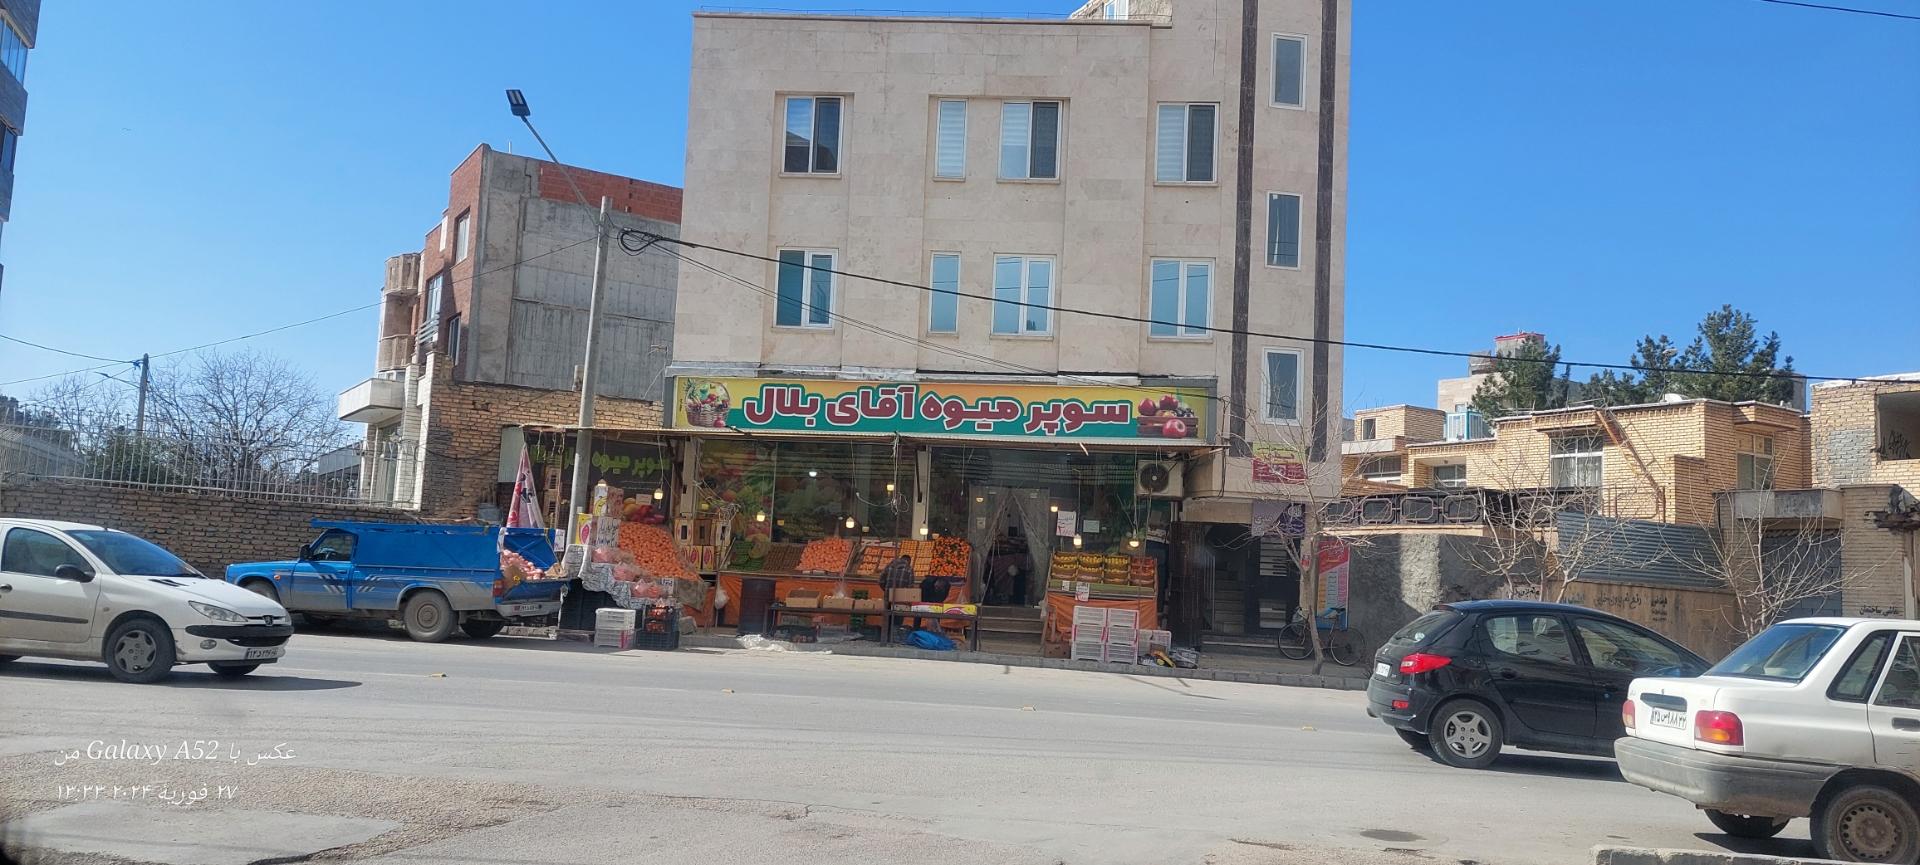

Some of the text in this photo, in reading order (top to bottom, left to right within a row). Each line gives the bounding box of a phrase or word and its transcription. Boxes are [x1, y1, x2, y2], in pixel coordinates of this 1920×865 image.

[744, 385, 1130, 435] سوپر میوه آقای بلال
[591, 451, 631, 474] میوه
